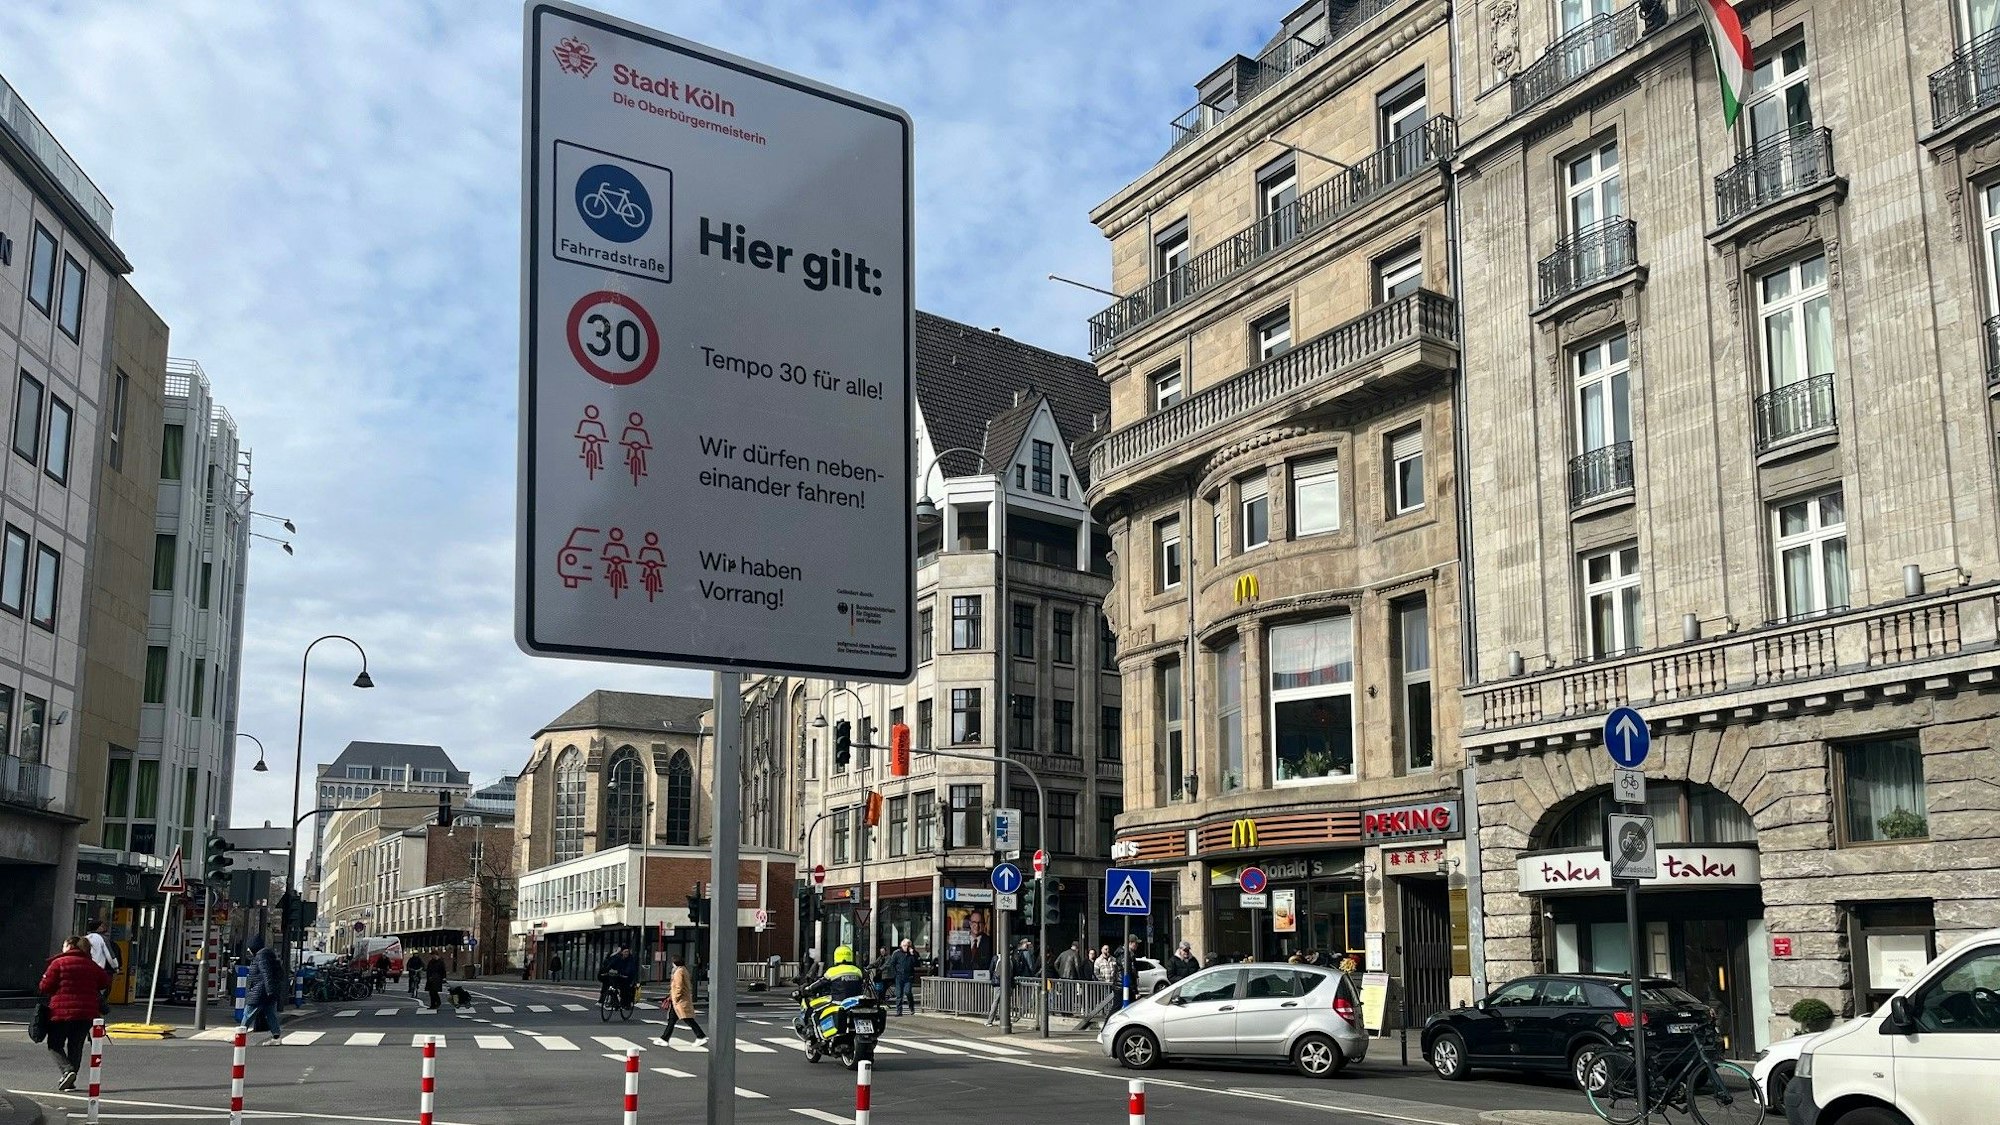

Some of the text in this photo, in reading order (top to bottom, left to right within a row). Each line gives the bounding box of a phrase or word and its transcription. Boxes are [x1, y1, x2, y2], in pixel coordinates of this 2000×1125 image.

[613, 63, 735, 117] Stadt Köln
[613, 91, 766, 146] Die Oberbürgermeisterin
[561, 238, 665, 273] Fahrradstraße
[700, 216, 882, 297] Hier gilt:
[586, 314, 641, 362] 30
[701, 346, 883, 400] Tempo 30 für alle!
[700, 435, 885, 483] Wir dürfen neben-
[700, 467, 866, 510] einander fahren!
[700, 550, 802, 581] Wir haben
[700, 579, 784, 611] Vorrang!
[1625, 790, 1636, 799] frei
[1365, 806, 1450, 833] PEKING
[1236, 859, 1324, 881] Donald's
[1541, 860, 1601, 884] taku
[1618, 864, 1654, 874] rradstraße
[1662, 854, 1736, 878] taku
[945, 889, 955, 900] U
